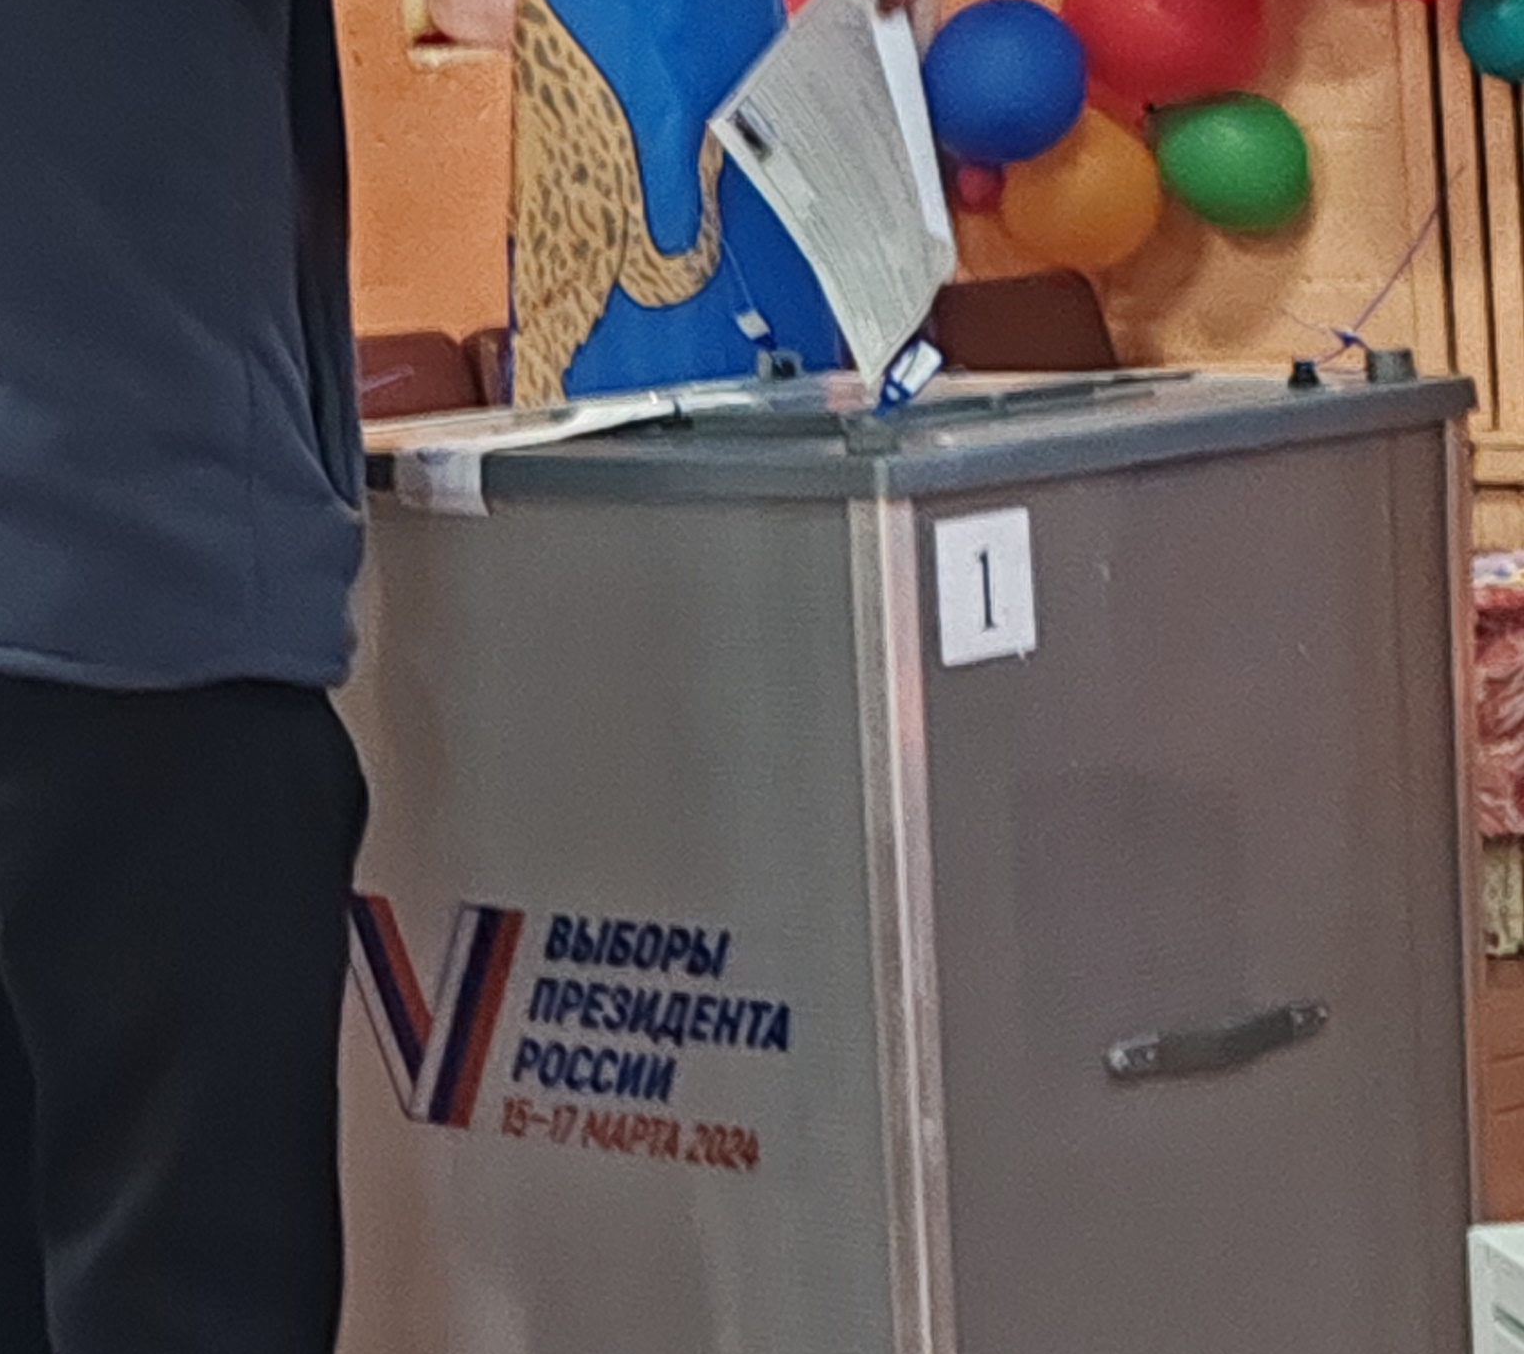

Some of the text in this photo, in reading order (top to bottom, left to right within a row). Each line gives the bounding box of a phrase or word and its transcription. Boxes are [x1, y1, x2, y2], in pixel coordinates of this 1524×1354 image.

[975, 547, 997, 632] 1
[544, 914, 731, 978] ВЫБОРЫ
[528, 978, 791, 1051] ПРЕЗИДЕНТА
[512, 1039, 676, 1101] РОССИИ
[582, 1111, 681, 1160] МАРТА
[685, 1122, 760, 1169] 2024
